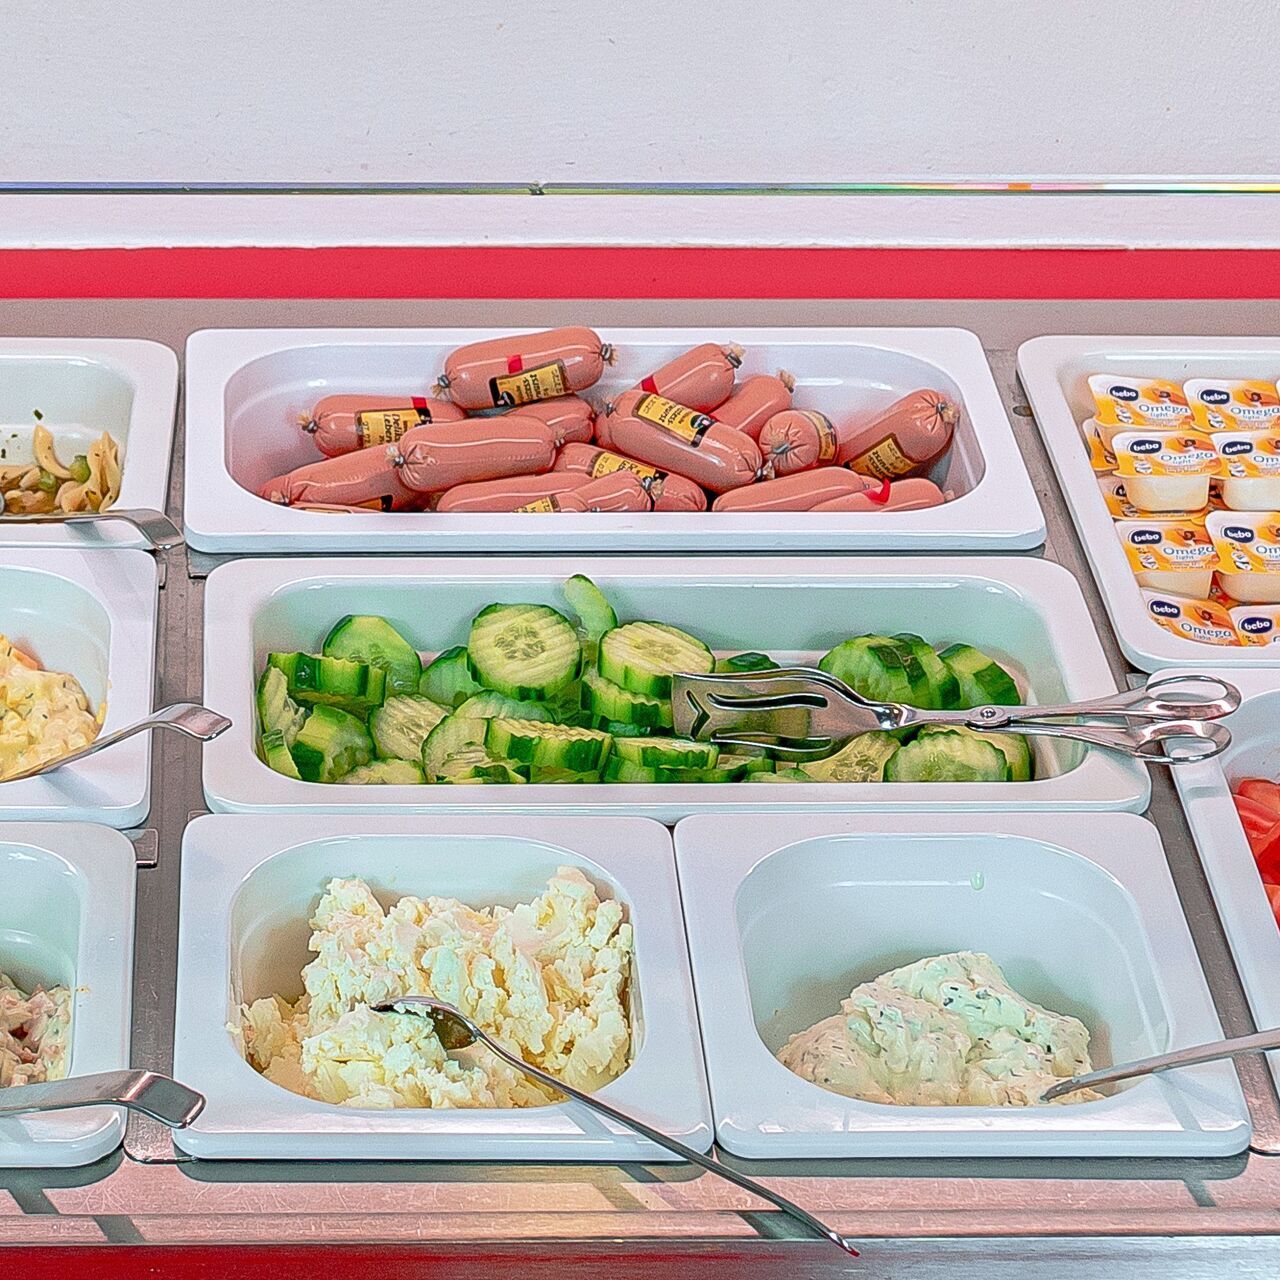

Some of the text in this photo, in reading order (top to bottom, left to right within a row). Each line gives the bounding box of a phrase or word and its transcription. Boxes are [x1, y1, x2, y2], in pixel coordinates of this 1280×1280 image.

[1112, 390, 1136, 398] bebo
[1203, 392, 1228, 401] bebo
[1139, 404, 1188, 418] Omega
[1231, 407, 1280, 419] Omega
[1134, 442, 1159, 452] bebo
[1225, 444, 1250, 453] bebo
[1161, 452, 1214, 464] Omega
[1134, 532, 1159, 541] bebo
[1227, 530, 1251, 538] bebo
[1153, 604, 1178, 614] bebo
[1244, 620, 1270, 630] bebo
[1181, 623, 1232, 638] Omega
